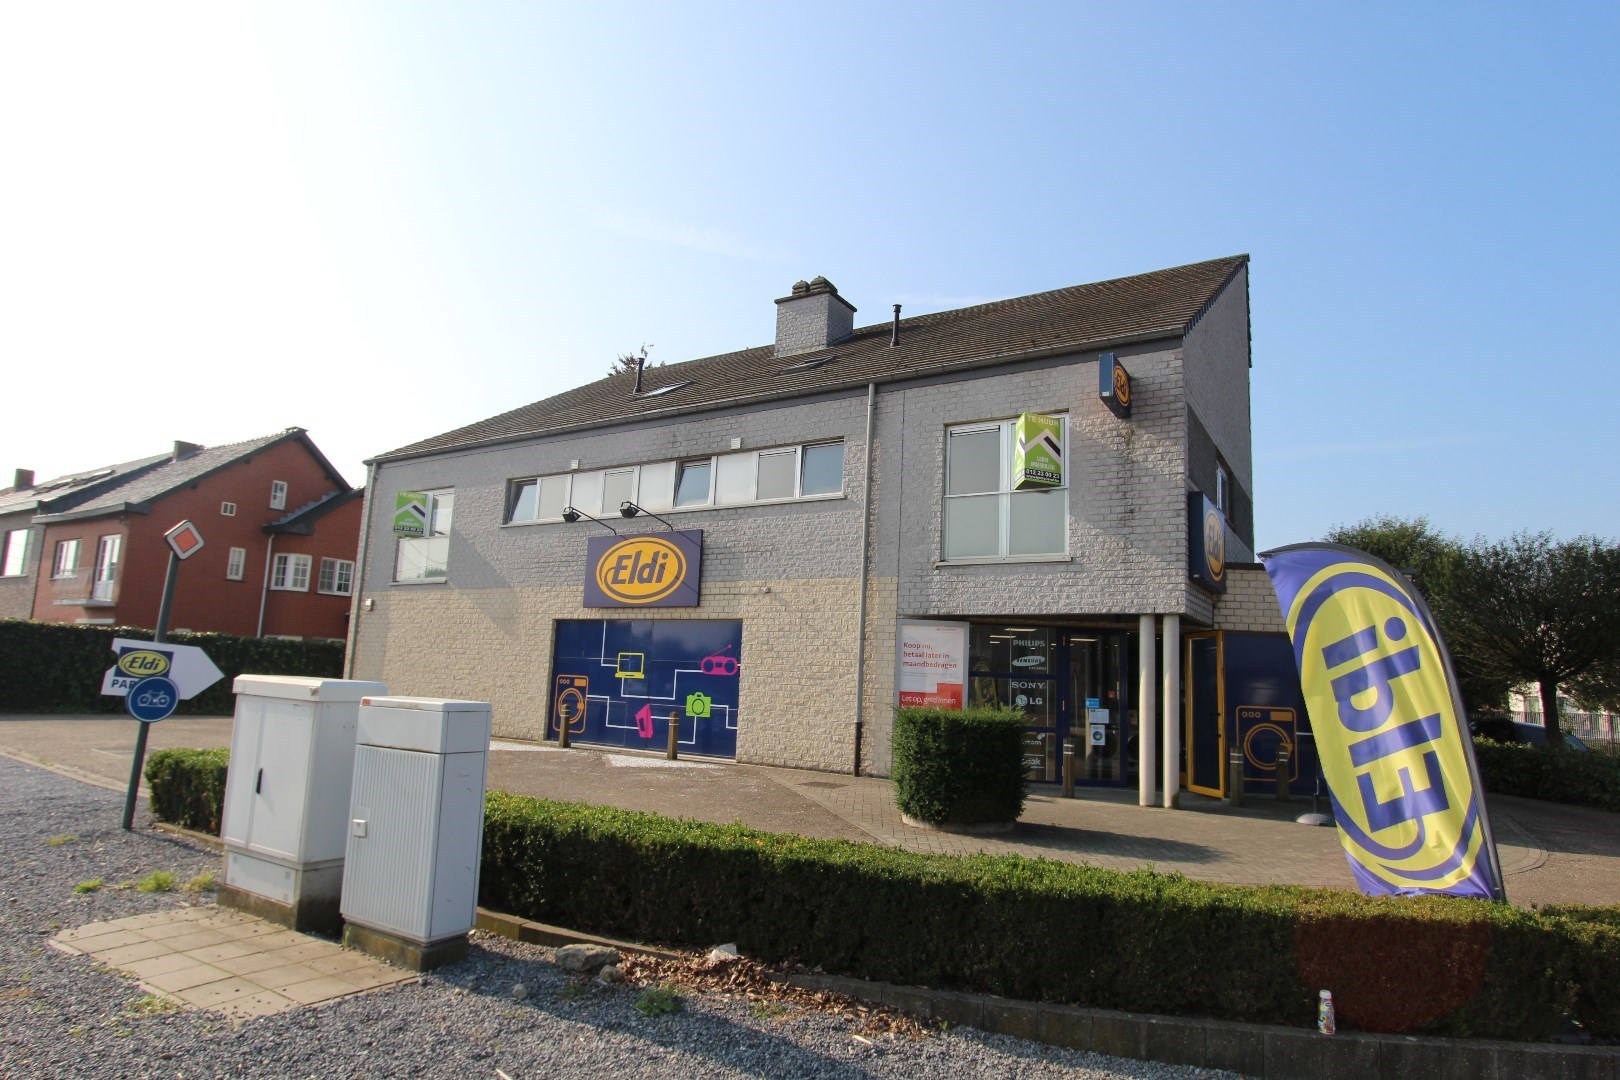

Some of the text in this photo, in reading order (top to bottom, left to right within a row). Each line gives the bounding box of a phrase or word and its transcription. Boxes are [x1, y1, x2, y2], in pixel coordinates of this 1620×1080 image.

[1028, 415, 1036, 423] TE
[1039, 417, 1060, 427] HUUR
[1207, 523, 1221, 562] Eldi
[608, 550, 669, 584] Eldi
[904, 642, 920, 650] Koop
[1013, 639, 1046, 647] PHILIPS
[925, 651, 941, 659] later
[128, 656, 162, 670] Eldi
[903, 660, 957, 670] maandbedragen
[1011, 681, 1046, 689] SONY
[1030, 697, 1043, 705] LG
